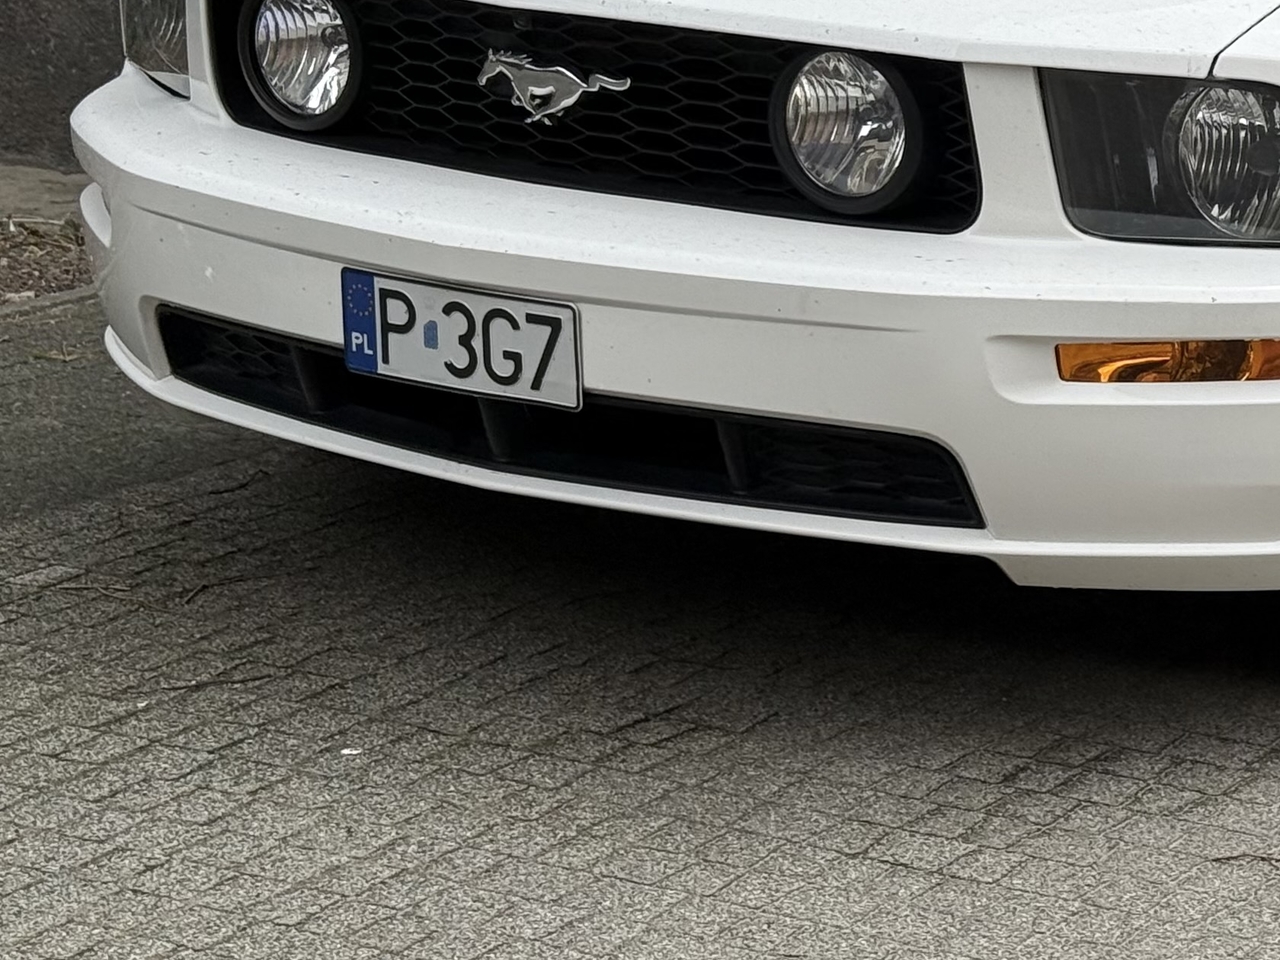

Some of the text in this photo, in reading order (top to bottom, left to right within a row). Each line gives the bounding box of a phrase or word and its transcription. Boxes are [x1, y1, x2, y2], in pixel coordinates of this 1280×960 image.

[351, 331, 374, 356] PL
[378, 287, 563, 391] P 3G7
